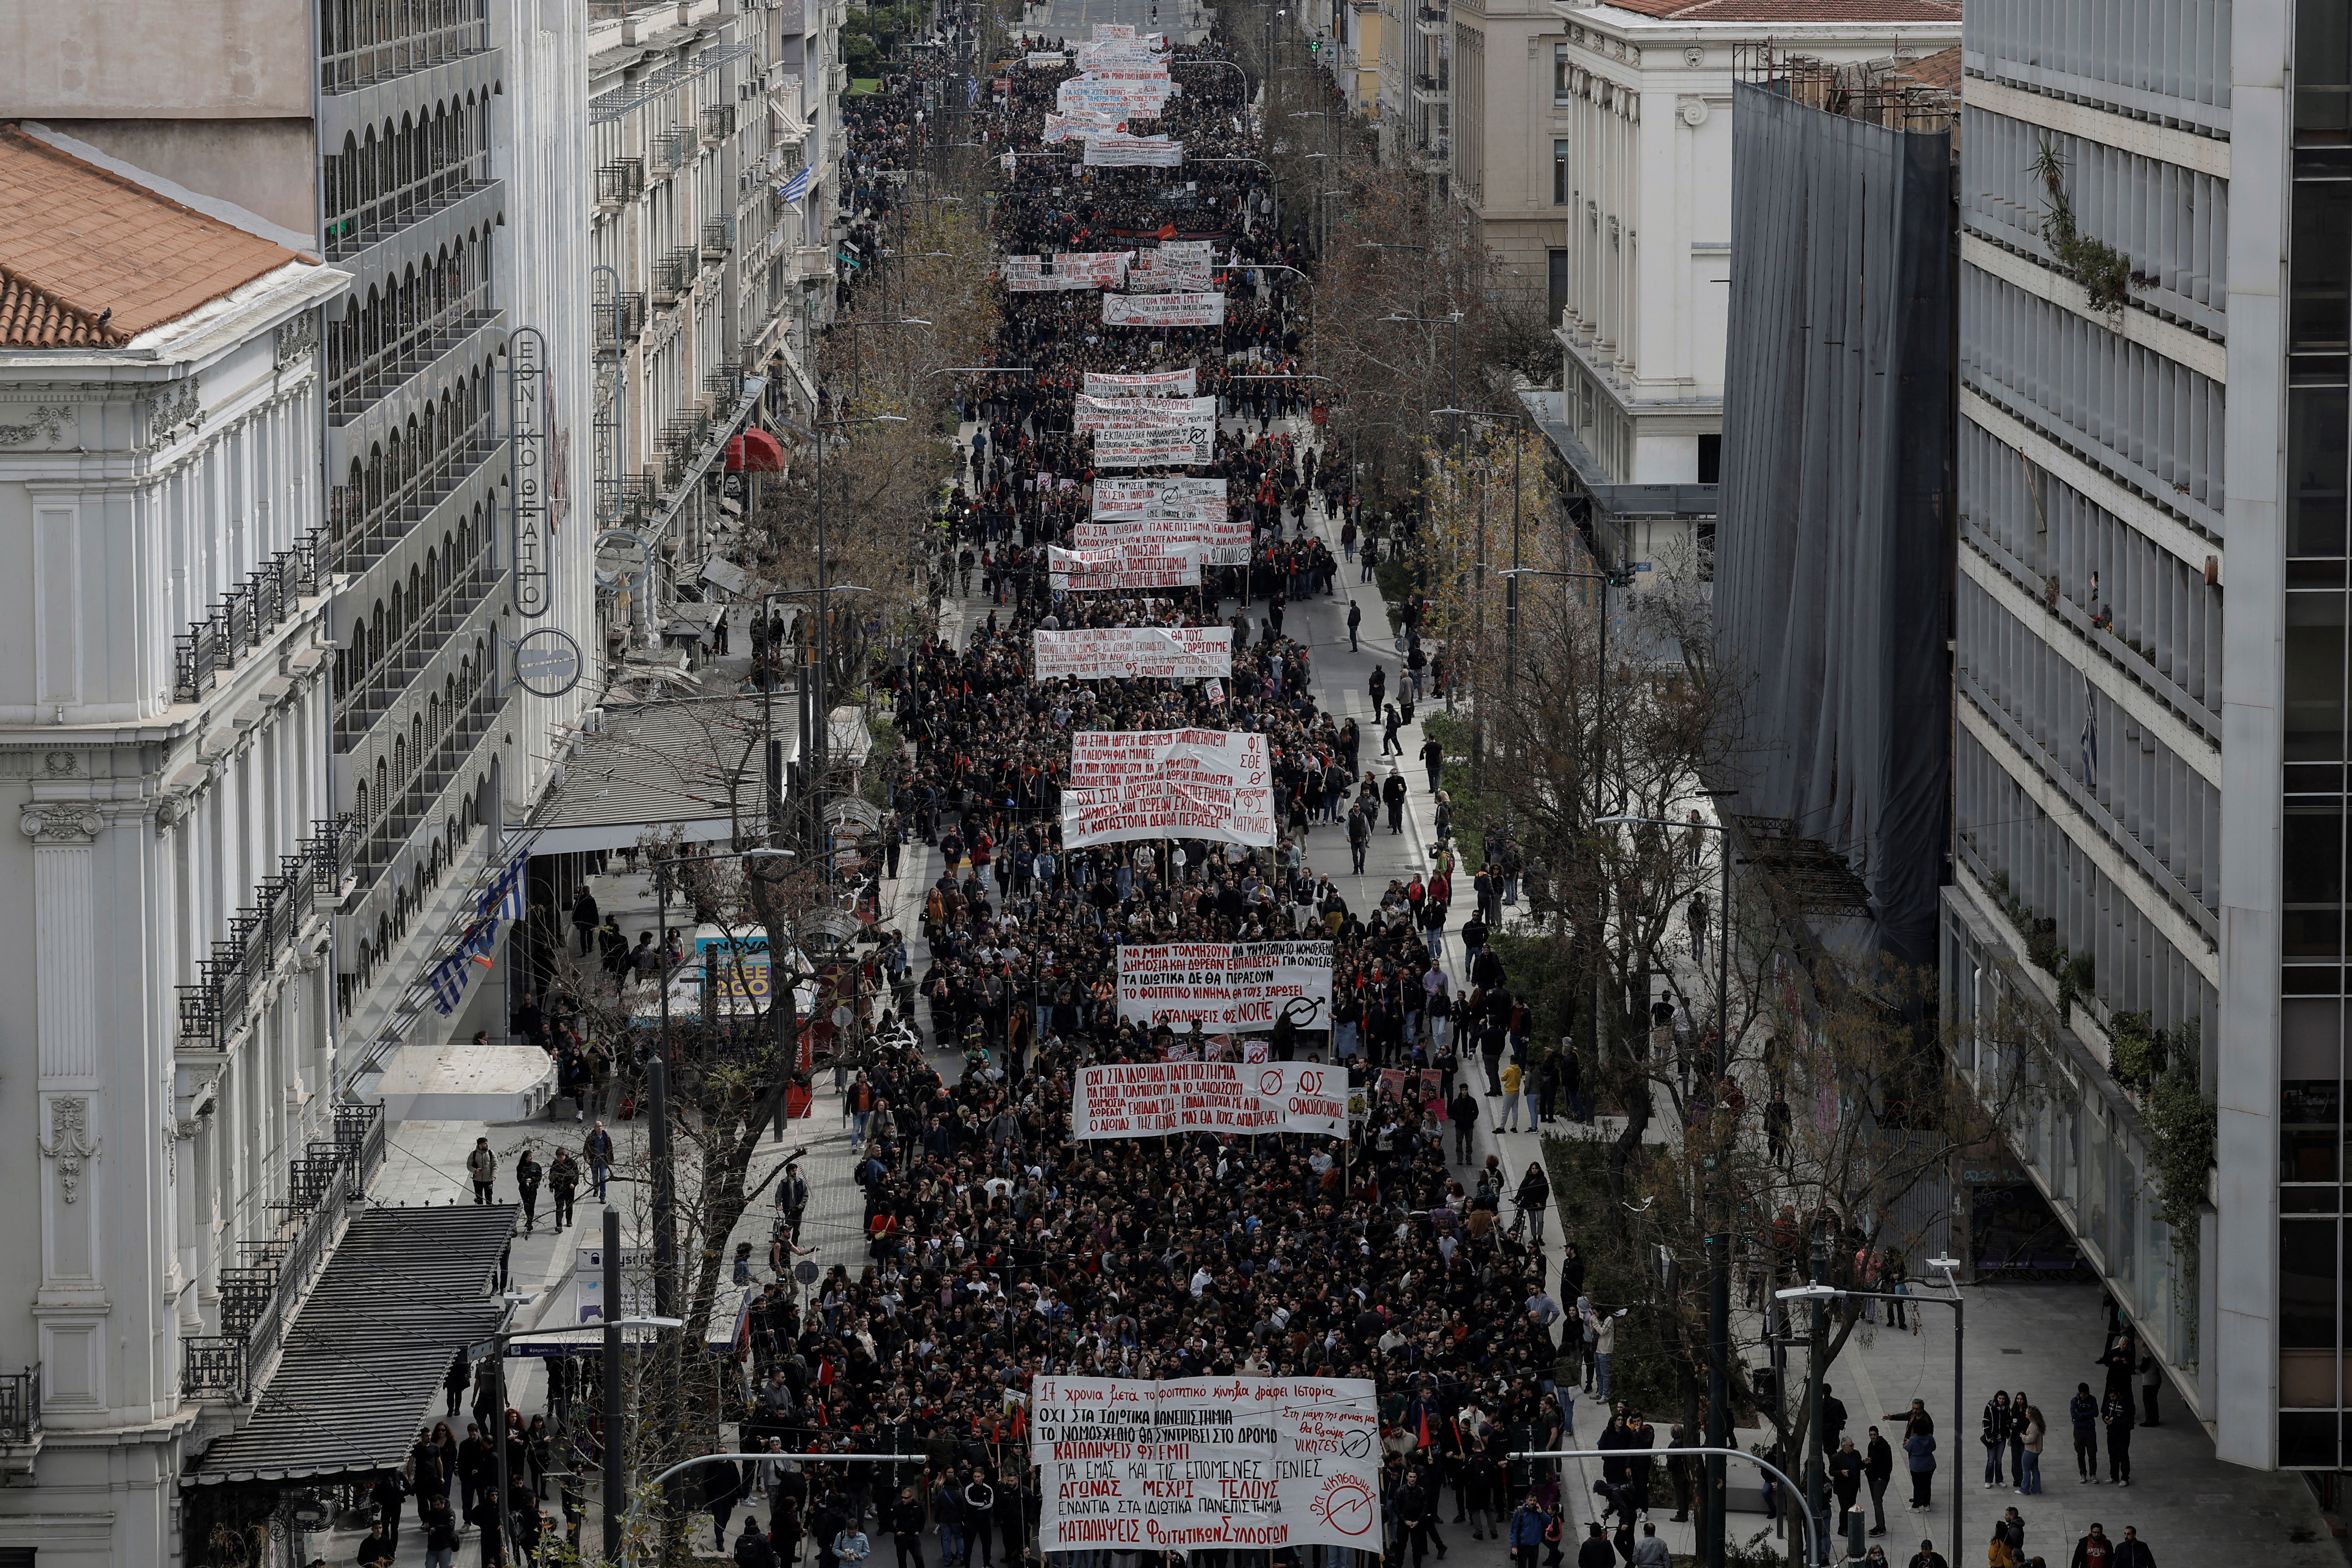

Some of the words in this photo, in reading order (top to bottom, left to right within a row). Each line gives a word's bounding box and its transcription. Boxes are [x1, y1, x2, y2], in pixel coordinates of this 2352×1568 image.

[1160, 296, 1182, 305] ΜΙΛΑΜΕ
[1184, 294, 1204, 304] ΕΜΕΙΣ!
[1088, 374, 1101, 383] ΟΧΙ
[1103, 375, 1116, 384] ΣΤΑ
[1118, 376, 1143, 384] ΙΔΙΩΤΙΚΑ
[519, 341, 537, 467] ΕΘΝΙΚΟ
[1076, 395, 1118, 406] ΕΡΧΟΜΑΣΤΕ
[1121, 399, 1130, 408] ΝΑ
[1132, 399, 1142, 408] ΣΑΣ
[1147, 399, 1194, 410] ΣΑΡΩΣΟΥΜΕ!
[1095, 480, 1114, 489] ΕΣΕΙΣ
[1118, 481, 1143, 490] ΨΗΦΙΖΕΤΕ
[1099, 490, 1110, 499] ΟΧΙ
[1112, 491, 1125, 500] ΣΤΑ
[1130, 490, 1154, 499] ΙΔΙΩΤΙΚΑ
[1099, 501, 1143, 512] ΠΑΝΕΠΙΣΤΗΜΙΑ
[1077, 525, 1090, 536] ΟΧΙ
[1093, 526, 1107, 537] ΣΤΑ
[1114, 523, 1143, 535] ΙΔΙΩΤΙΚΑ
[1150, 522, 1210, 532] ΠΑΝΕΠΙΣΤΗΜΙΑ
[519, 478, 540, 604] ΘΕΑΤΡΟ
[1038, 632, 1051, 643] ΟΧΙ
[1054, 632, 1065, 643] ΣΤΑ
[1069, 630, 1091, 643] ΙΔΙΩΤΙΚΑ
[1093, 630, 1132, 641] ΠΑΝΕΠΙΣΤΗΜΙΑ
[1171, 630, 1182, 641] ΘΑ
[1184, 629, 1203, 641] ΤΟΥΣ
[1183, 641, 1228, 654] ΣΑΡΩΣΟΥΜΕ
[1142, 665, 1175, 676] ΠΑΝΤΕΙΟΥ
[1248, 735, 1261, 753] ΦΣ
[1240, 754, 1261, 769] ΣΘΕ
[1077, 790, 1096, 805] ΟΧΙ
[1099, 787, 1118, 804] ΣΤΑ
[1124, 782, 1162, 800] ΙΔΙΩΤΙΚΑ
[1167, 782, 1230, 804] ΠΑΝΕΠΙΣΤΗΜΙΑ
[1078, 822, 1086, 836] Η
[1091, 813, 1147, 834] ΚΑΤΑΣΤΟΛΗ
[1150, 813, 1166, 827] ΔΕΝ
[1167, 812, 1176, 826] ΘΑ
[1179, 813, 1220, 829] ΠΕΡΑΣΕΙ
[1234, 815, 1270, 834] ΙΑΤΡΙΚΗΣ
[1122, 974, 1136, 985] ΤΑ
[1140, 973, 1184, 985] ΙΔΙΩΤΙΚΑ
[1189, 972, 1202, 984] ΔΕ
[1205, 972, 1221, 985] ΘΑ
[1226, 970, 1274, 984] ΠΕΡΑΣΟΥΝ
[1122, 988, 1136, 1000] ΤΟ
[1140, 986, 1191, 999] ΦΟΙΤΗΤΙΚΟ
[1193, 986, 1231, 1000] ΚΙΝΗΜΑ
[1232, 989, 1241, 999] ΘΑ
[1243, 987, 1262, 997] ΤΟΥΣ
[1265, 985, 1303, 997] ΣΑΡΩΣΕΙ
[1223, 1009, 1237, 1024] ΦΣ
[1238, 1001, 1274, 1022] ΝΟΠΕ
[1085, 1069, 1103, 1086] ΟΧΙ
[1107, 1067, 1124, 1084] ΣΤΑ
[1126, 1066, 1165, 1083] ΙΔΙΩΤΙΚΑ
[1167, 1063, 1236, 1081] ΠΑΝΕΠΙΣΤΗΜΙΑ
[1087, 1087, 1098, 1098] ΝΑ
[1100, 1085, 1118, 1098] ΜΗΝ
[1122, 1083, 1167, 1098] ΤΟΛΜΗΣΟΥΝ
[1170, 1083, 1180, 1094] ΝΑ
[1183, 1082, 1192, 1093] ΤΟ
[1196, 1082, 1243, 1095] ΨΗΦΙΣΟΥΝ
[1289, 1097, 1345, 1119] ΦΙΛΟΣΟΦΙΚΗΣ
[1089, 1120, 1098, 1132] Ο
[1100, 1117, 1131, 1131] ΑΓΩΝΑΣ
[1137, 1115, 1152, 1130] ΤΗΣ
[1156, 1112, 1178, 1130] ΓΕΝΙΑΣ
[1181, 1110, 1198, 1125] ΜΑΣ
[1200, 1110, 1212, 1124] ΘΑ
[1216, 1110, 1234, 1125] ΤΟΥΣ
[1236, 1110, 1279, 1127] ΑΝΑΤΡΕΨΕΙ
[1040, 1382, 1056, 1401] 17
[1107, 1384, 1139, 1408] μετά
[1144, 1392, 1155, 1400] το
[1158, 1384, 1207, 1404] φοιτητικό
[1212, 1380, 1250, 1401] κίνημα
[1254, 1385, 1289, 1401] γράφει
[1039, 1408, 1065, 1423] ΟΧΙ
[1071, 1408, 1094, 1423] ΣΤΑ
[1098, 1409, 1150, 1425] ΙΔΙΩΤΙΚΑ
[1154, 1409, 1232, 1425] ΠΑΝΕΠΙΣΤΗΜΙΑ
[1282, 1406, 1299, 1421] Στη
[1302, 1409, 1324, 1421] μάχη
[1325, 1412, 1338, 1422] της
[1339, 1412, 1363, 1423] γενιάς
[1364, 1415, 1375, 1426] μα
[1038, 1427, 1055, 1441] ΤΟ
[1061, 1426, 1135, 1443] ΝΟΜΟΣΧΕΔΙΟ
[1139, 1426, 1153, 1444] ΘΑ
[1156, 1427, 1210, 1443] ΣΥΝΤΡΙΒΕΙ
[1212, 1428, 1234, 1444] ΣΤΟ
[1238, 1427, 1277, 1444] ΔΡΟΜΟ
[1298, 1421, 1312, 1434] θα
[1315, 1422, 1345, 1439] βγούμε
[1053, 1441, 1132, 1461] ΚΑΤΑΛΗΨΕΙΣ
[1137, 1444, 1154, 1460] ΦΣ
[1159, 1443, 1189, 1460] ΕΜΠ
[1059, 1462, 1076, 1481] ΓΙΑ
[1086, 1461, 1116, 1479] ΕΜΑΣ
[1129, 1462, 1147, 1479] ΚΑΙ
[1155, 1463, 1177, 1480] ΤΙΣ
[1186, 1460, 1262, 1479] ΕΠΟΜΕΝΕΣ
[1275, 1459, 1323, 1479] ΓΕΝΙΕΣ
[1058, 1480, 1122, 1499] ΑΓΩΝΑΣ
[1143, 1480, 1194, 1498] ΜΕΧΡΙ
[1218, 1479, 1279, 1499] ΤΕΛΟΥΣ
[1058, 1499, 1110, 1515] ΕΝΑΝΤΙΑ
[1117, 1500, 1142, 1514] ΣΤΑ
[1145, 1500, 1192, 1515] ΙΔΙΩΤΙΚΑ
[1198, 1497, 1281, 1513] ΠΑΝΕΠΙΣΤΗΜΙΑ
[1058, 1519, 1140, 1543] ΚΑΤΑΛΗΨΕΙΣ
[1146, 1518, 1221, 1544] ΦΟΙΤΗΤΙΚΩΝ
[1221, 1515, 1289, 1545] ΣΥΛΛΟΓΩΝ
